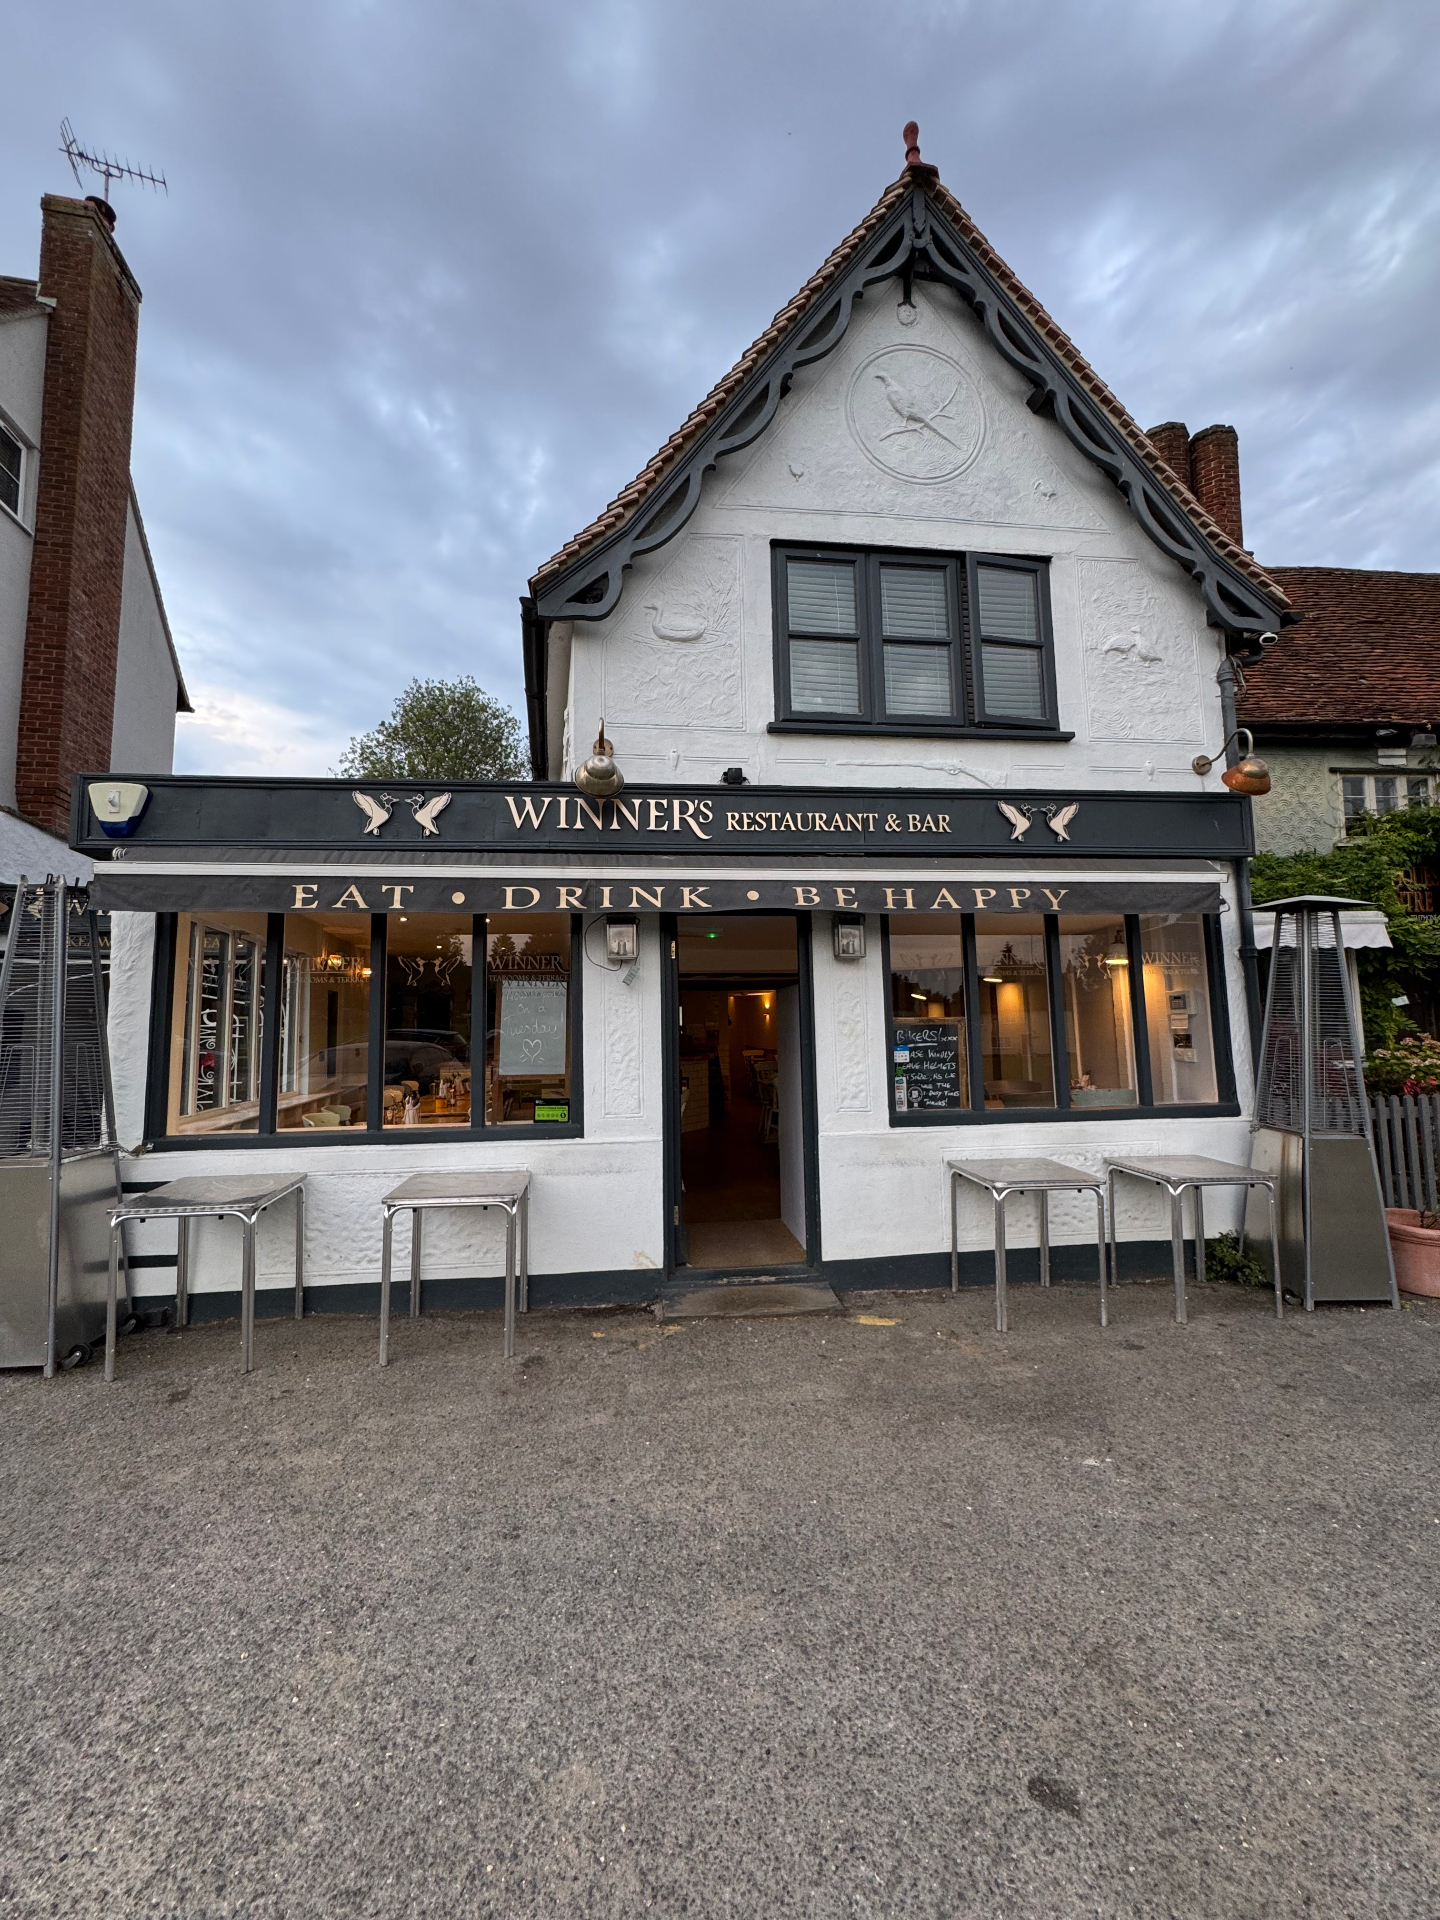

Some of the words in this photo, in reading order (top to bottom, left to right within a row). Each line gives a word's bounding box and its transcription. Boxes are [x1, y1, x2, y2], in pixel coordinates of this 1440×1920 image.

[505, 796, 713, 839] WINNER'S
[725, 811, 878, 832] RESTAURANT
[884, 813, 902, 832] &
[907, 813, 952, 833] BAR
[290, 884, 414, 909] EAT
[501, 886, 713, 910] DRINK
[792, 886, 858, 908] BE
[882, 887, 1069, 911] HAPPY
[902, 1061, 921, 1070] EAVE
